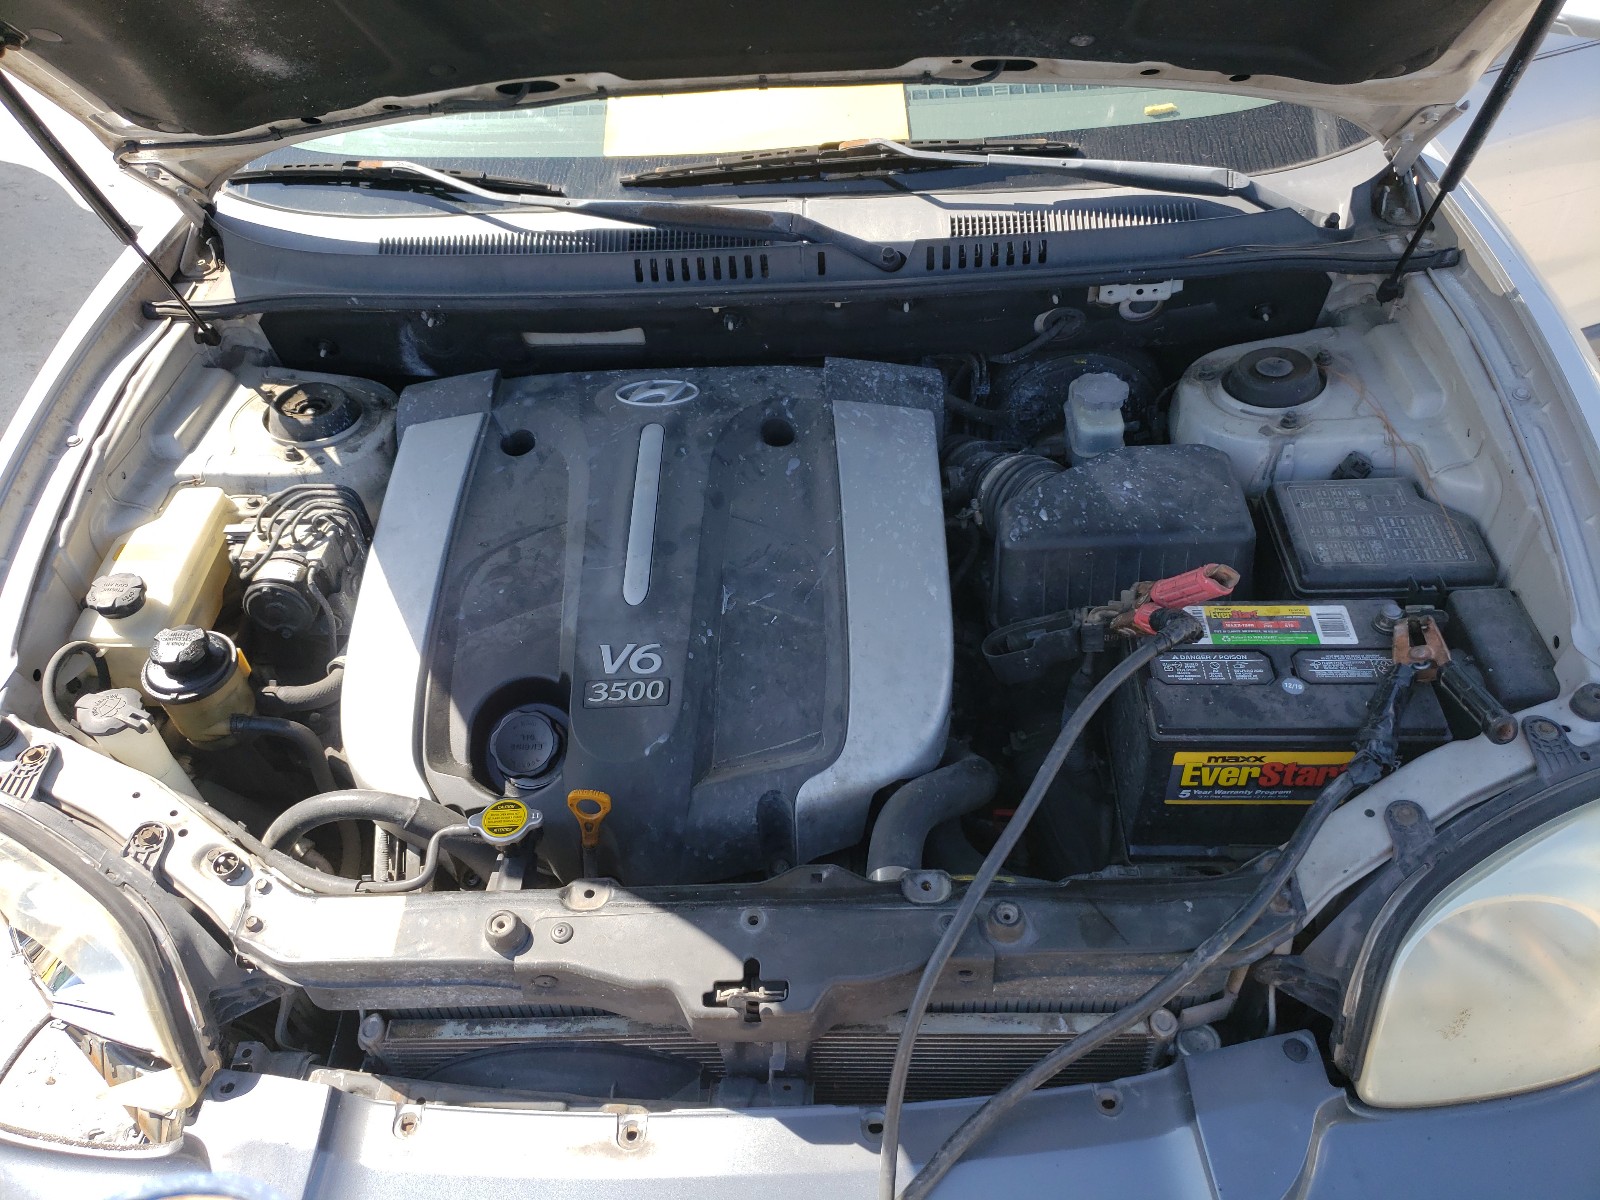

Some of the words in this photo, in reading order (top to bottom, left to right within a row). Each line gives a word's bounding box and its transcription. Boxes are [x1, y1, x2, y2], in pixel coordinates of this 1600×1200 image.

[1209, 609, 1259, 619] EverStart
[600, 643, 662, 674] V6
[588, 680, 665, 702] 3500
[1207, 755, 1267, 763] maxx
[1178, 789, 1192, 798] 5
